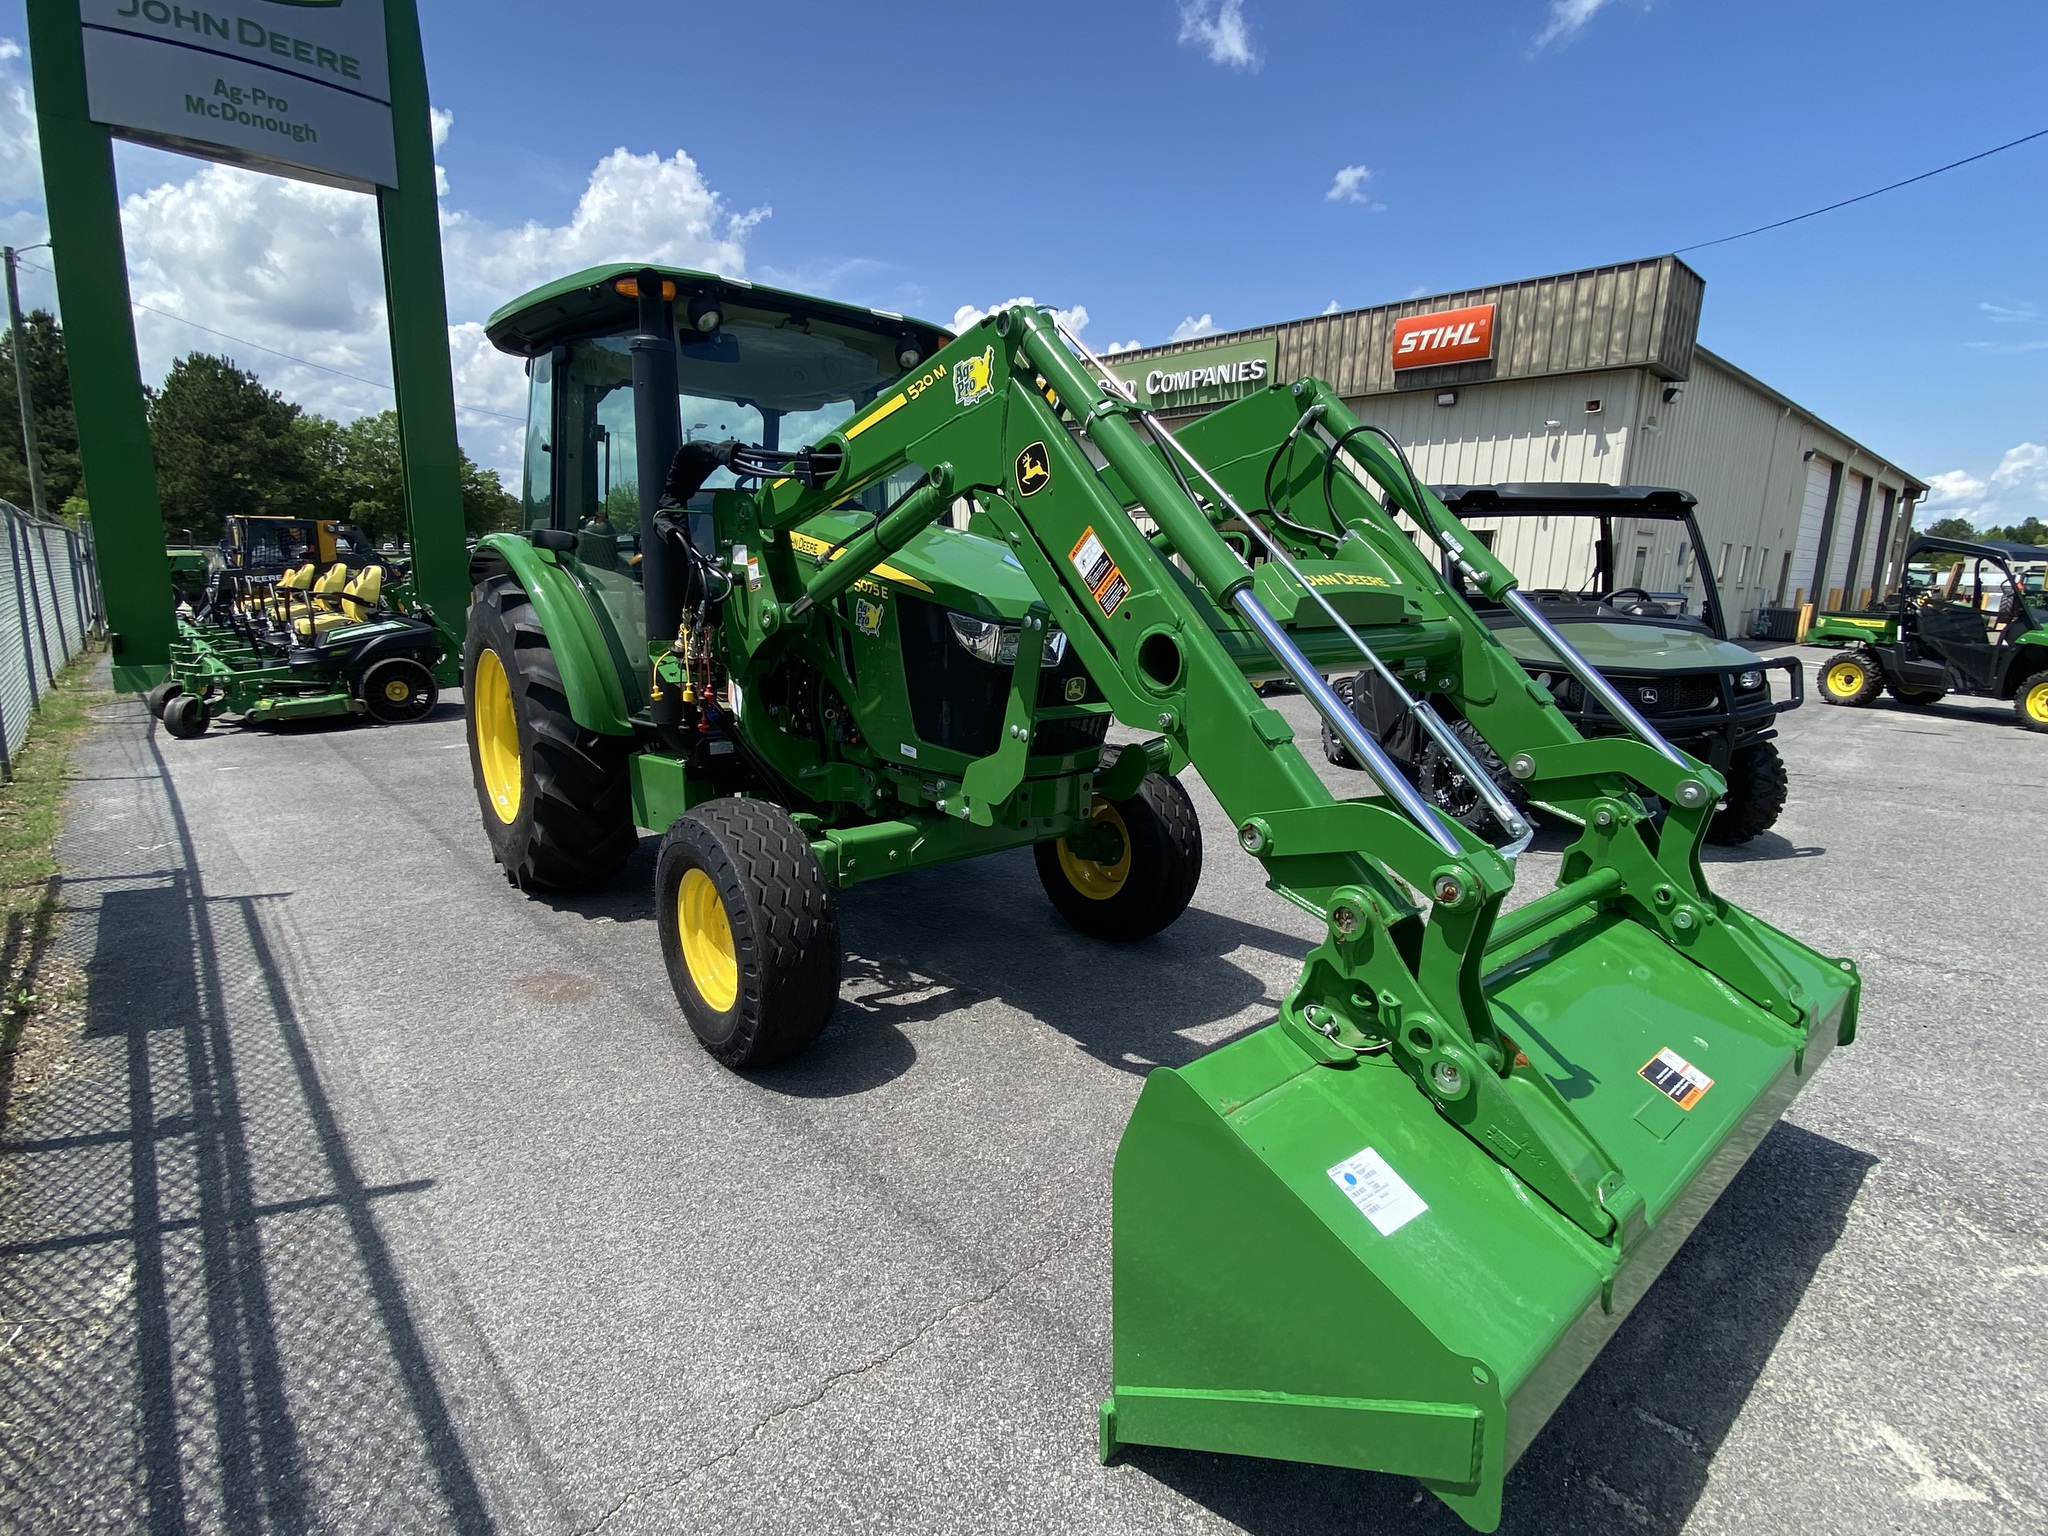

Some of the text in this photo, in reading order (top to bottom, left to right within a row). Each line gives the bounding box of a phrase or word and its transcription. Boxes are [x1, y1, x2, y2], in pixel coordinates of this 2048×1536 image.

[117, 0, 362, 81] JOHN DEERE
[213, 79, 288, 113] Ag-Pro
[185, 94, 318, 144] McDonough
[1397, 322, 1481, 354] STIHL
[906, 364, 948, 400] 520 M
[955, 378, 977, 400] Pro
[1146, 359, 1267, 395] COMPANIES
[799, 537, 819, 554] DEERE
[854, 579, 889, 600] 5075 E
[1334, 572, 1391, 588] DEERE
